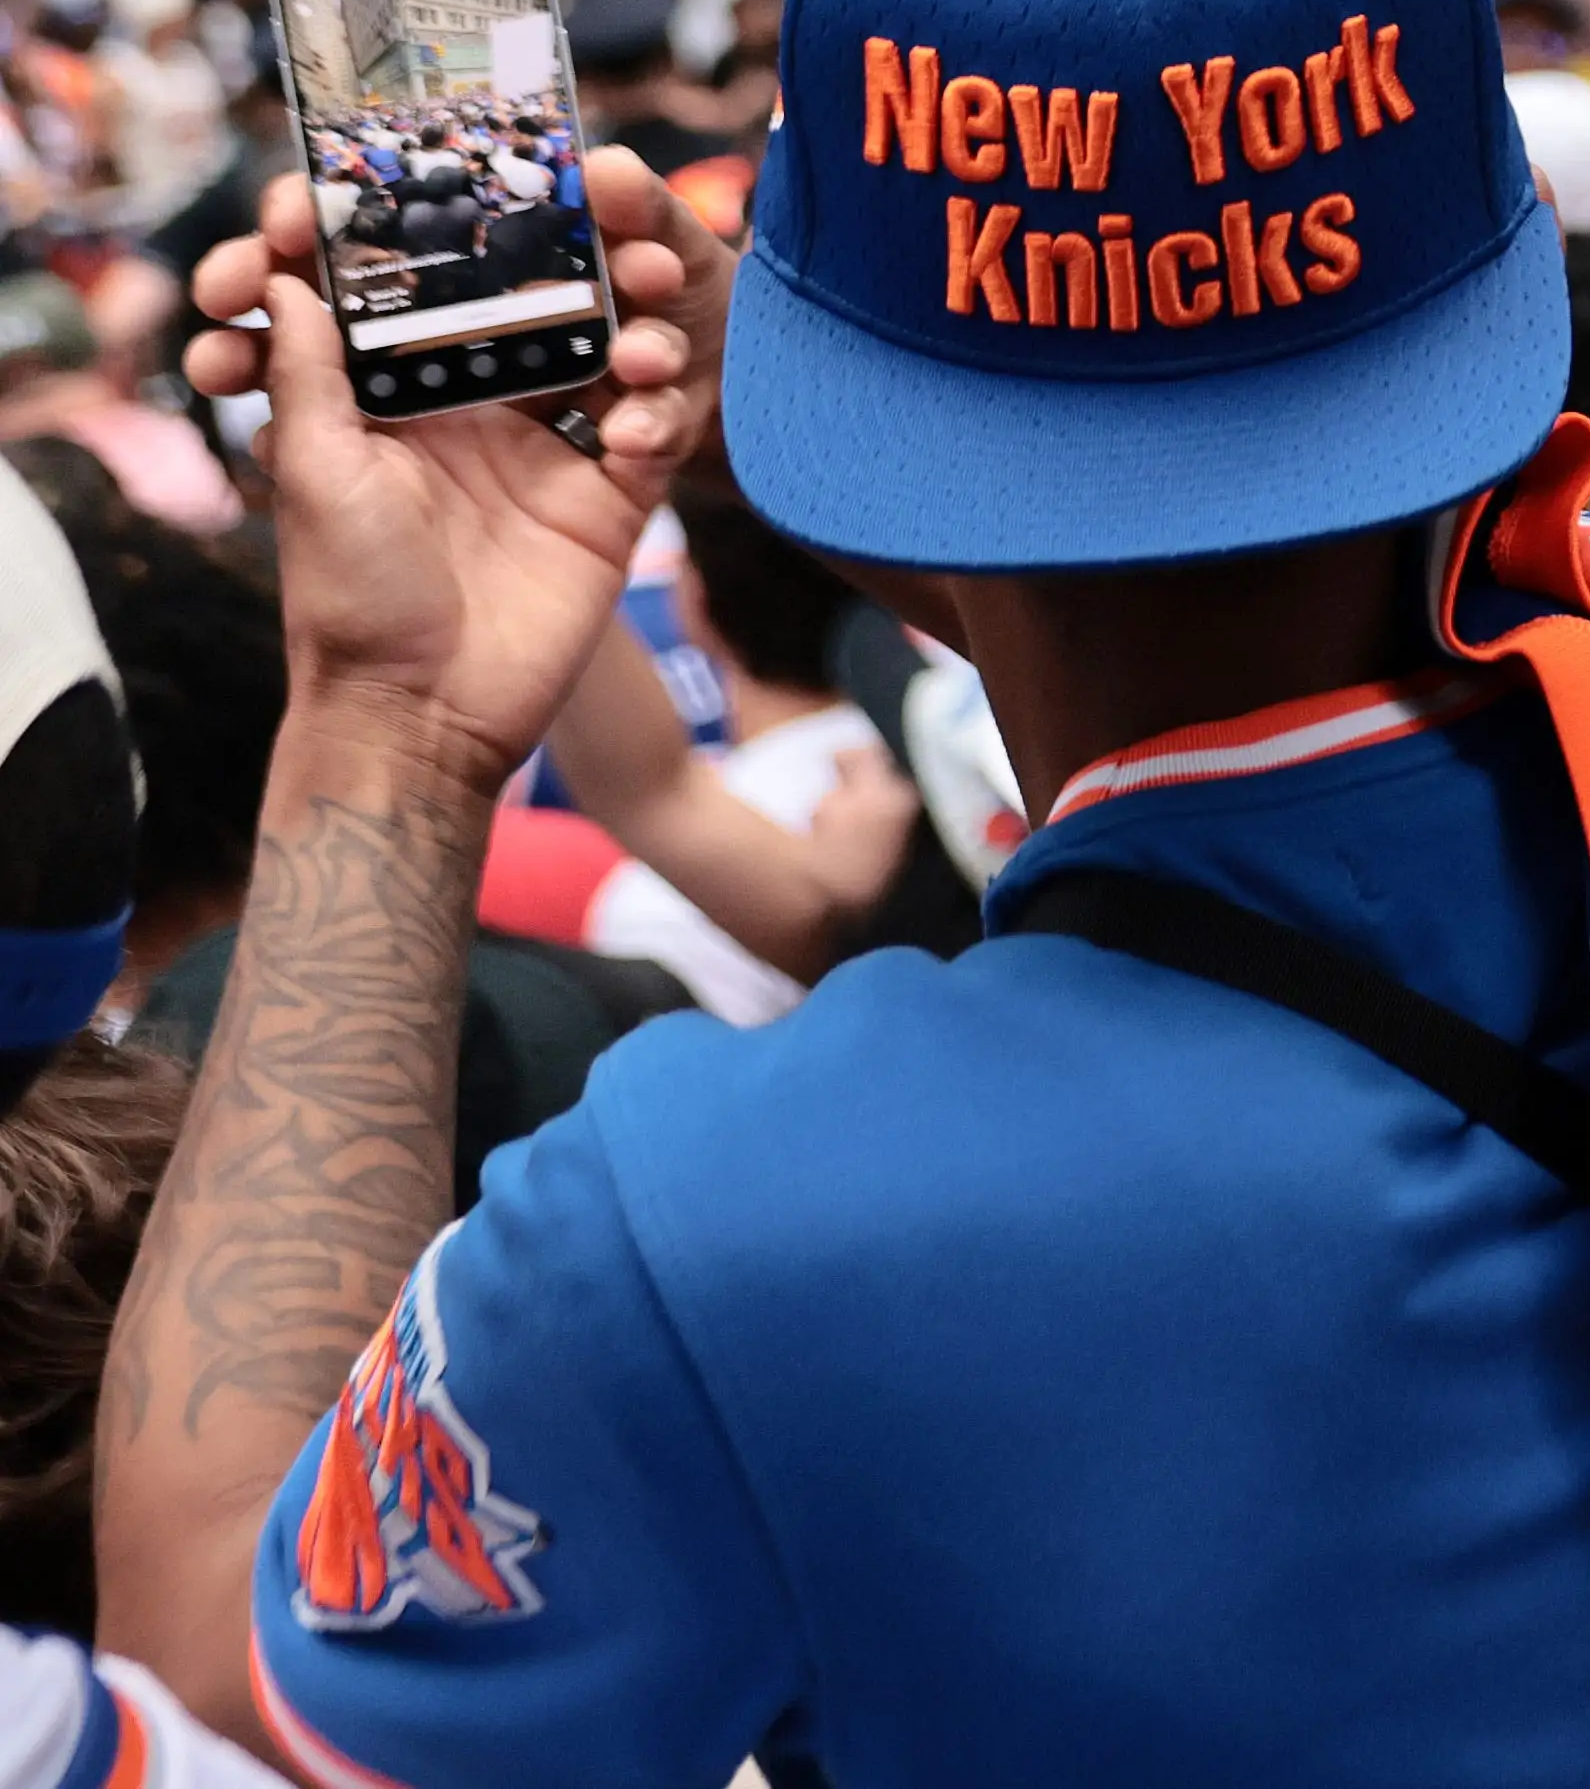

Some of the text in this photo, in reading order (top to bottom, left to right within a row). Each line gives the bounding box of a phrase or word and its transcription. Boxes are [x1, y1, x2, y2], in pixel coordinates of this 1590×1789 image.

[863, 14, 1415, 192] New York
[945, 192, 1361, 333] Knicks
